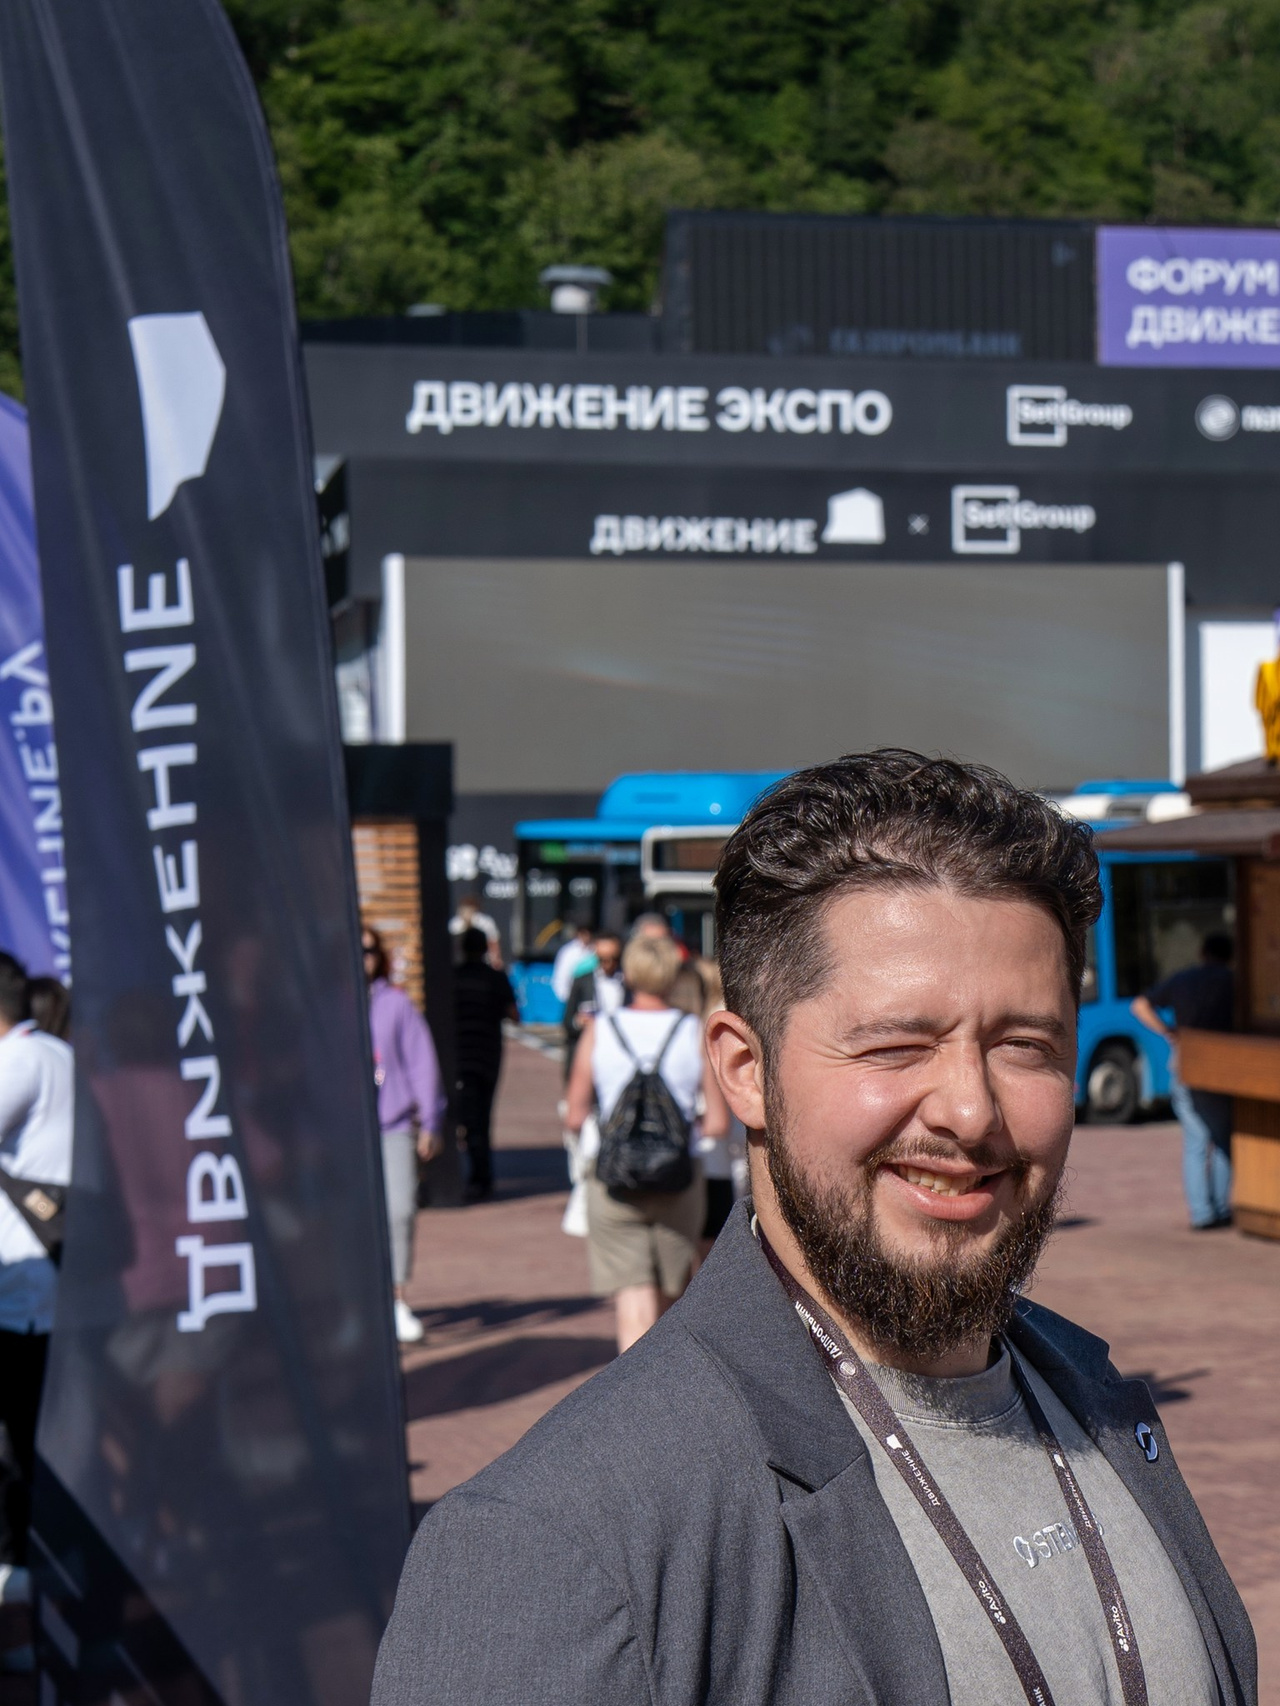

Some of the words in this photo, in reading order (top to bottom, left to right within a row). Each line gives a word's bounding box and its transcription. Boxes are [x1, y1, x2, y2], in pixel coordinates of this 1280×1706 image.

[1127, 257, 1280, 297] ФОРУМ
[405, 380, 710, 435] ДВИЖЕНИЕ
[715, 386, 894, 436] ЭКСПО
[590, 514, 818, 556] ДВИЖЕНИЕ
[901, 1449, 941, 1507] ДВИЖЕНИЕ
[978, 1580, 1000, 1611] Avito
[1111, 1605, 1125, 1637] Avito
